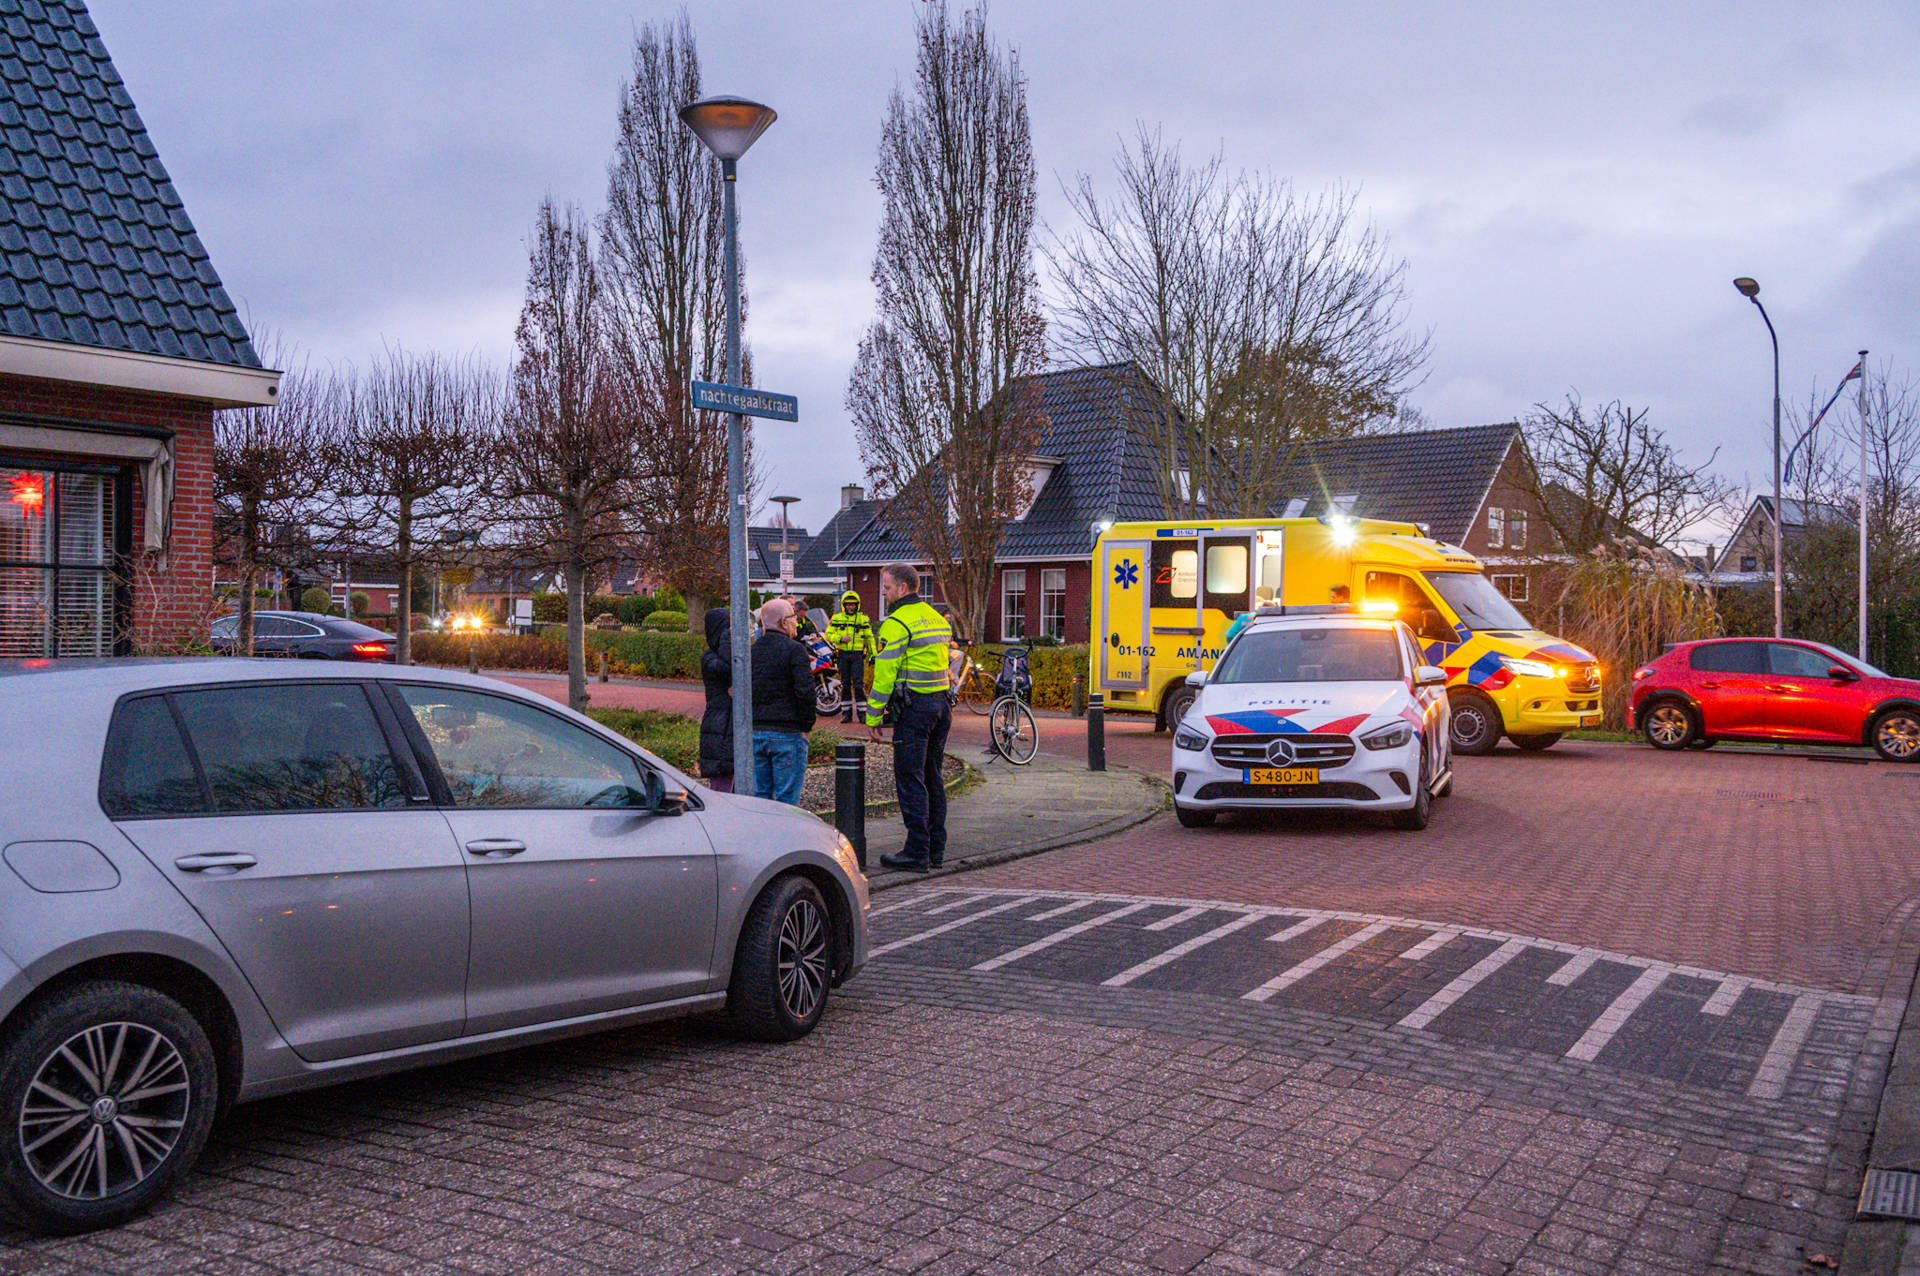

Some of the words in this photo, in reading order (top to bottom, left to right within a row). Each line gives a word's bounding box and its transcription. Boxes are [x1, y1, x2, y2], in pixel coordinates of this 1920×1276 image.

[700, 389, 794, 414] nachtegaalstraat
[1118, 645, 1156, 657] 01-162
[1120, 671, 1132, 679] 112
[1253, 770, 1313, 782] S-480-JN
